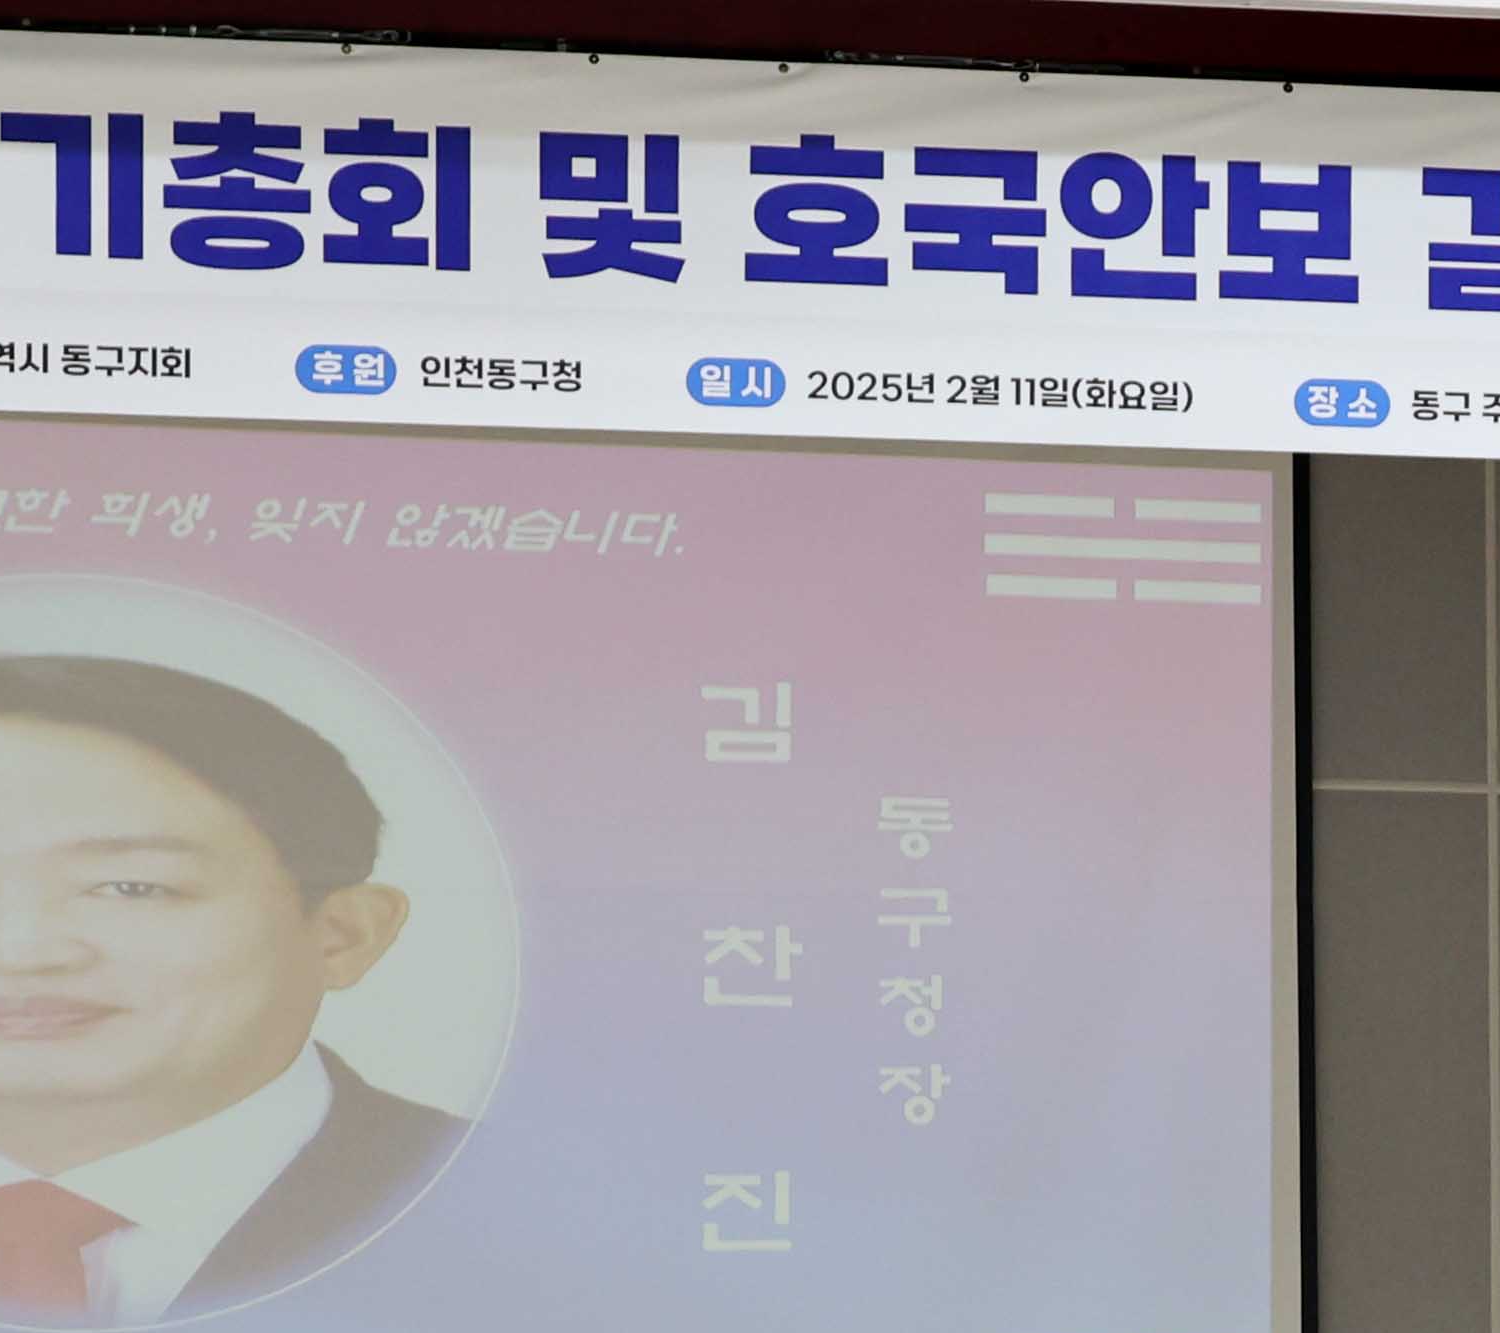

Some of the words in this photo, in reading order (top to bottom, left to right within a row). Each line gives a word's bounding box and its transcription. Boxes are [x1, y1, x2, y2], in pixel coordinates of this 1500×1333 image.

[538, 131, 687, 284] 및
[743, 134, 1360, 304] 호국안보
[60, 344, 192, 378] 동구지회
[420, 355, 583, 393] 인천동구청
[807, 371, 936, 404] 2025년
[946, 374, 1001, 406] 2월
[1010, 376, 1194, 412] 11일(화요일)
[1411, 390, 1472, 422] 동구
[91, 491, 218, 544] 희생,
[249, 497, 366, 545] 잊지
[386, 503, 686, 558] 않겠습니다.
